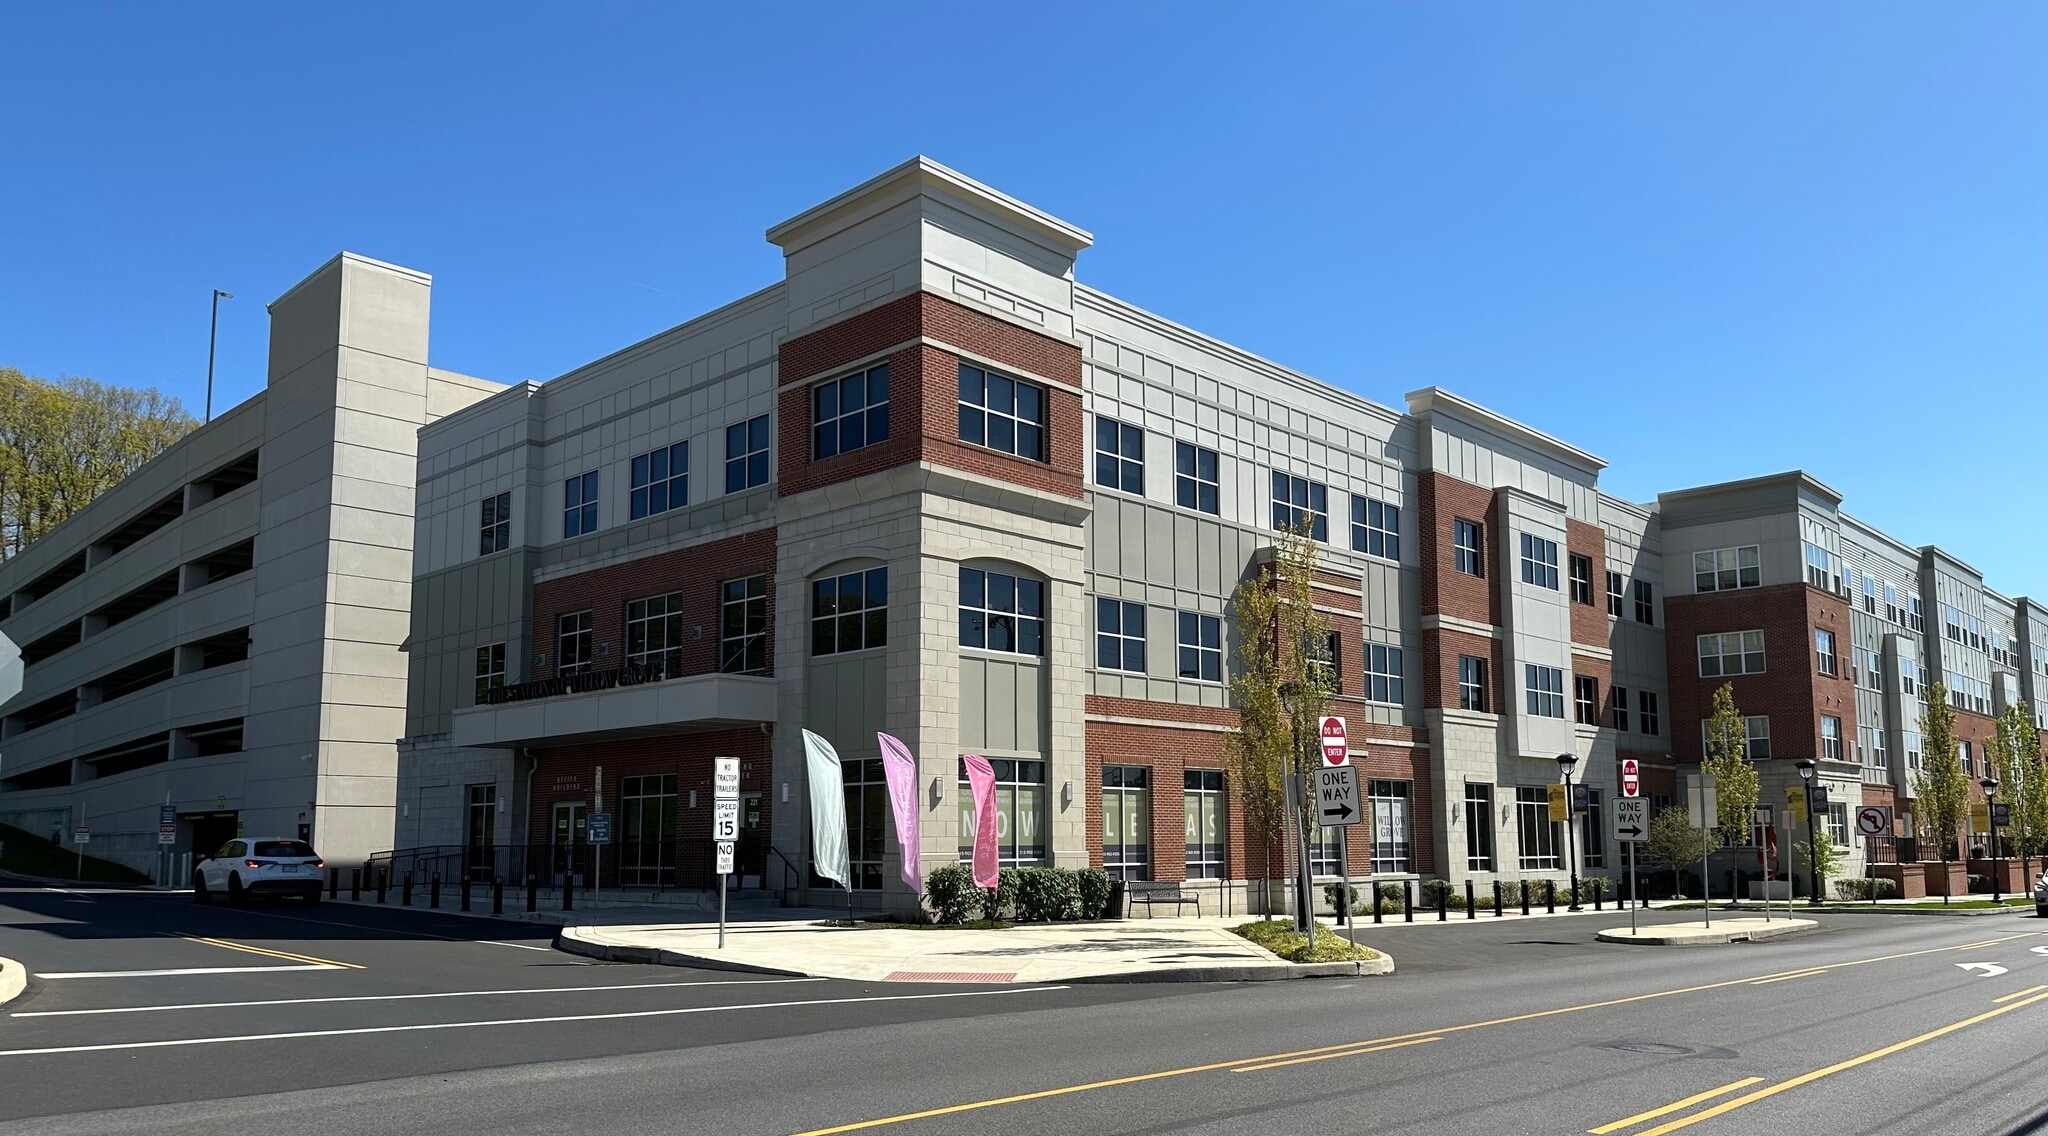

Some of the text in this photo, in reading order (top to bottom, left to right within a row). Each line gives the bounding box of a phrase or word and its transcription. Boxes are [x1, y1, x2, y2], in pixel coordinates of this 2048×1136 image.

[1324, 727, 1342, 735] DO NOT
[1327, 748, 1343, 756] ENTER
[717, 774, 737, 782] TRACTOR
[1322, 771, 1349, 786] ONE
[716, 785, 738, 793] TRAILERS
[1322, 787, 1350, 801] WAY
[1618, 801, 1641, 811] ONE
[1377, 815, 1406, 826] WILOW
[1618, 813, 1642, 823] WAY
[719, 821, 734, 836] 15
[1381, 827, 1404, 838] GRVE
[719, 844, 733, 855] NO
